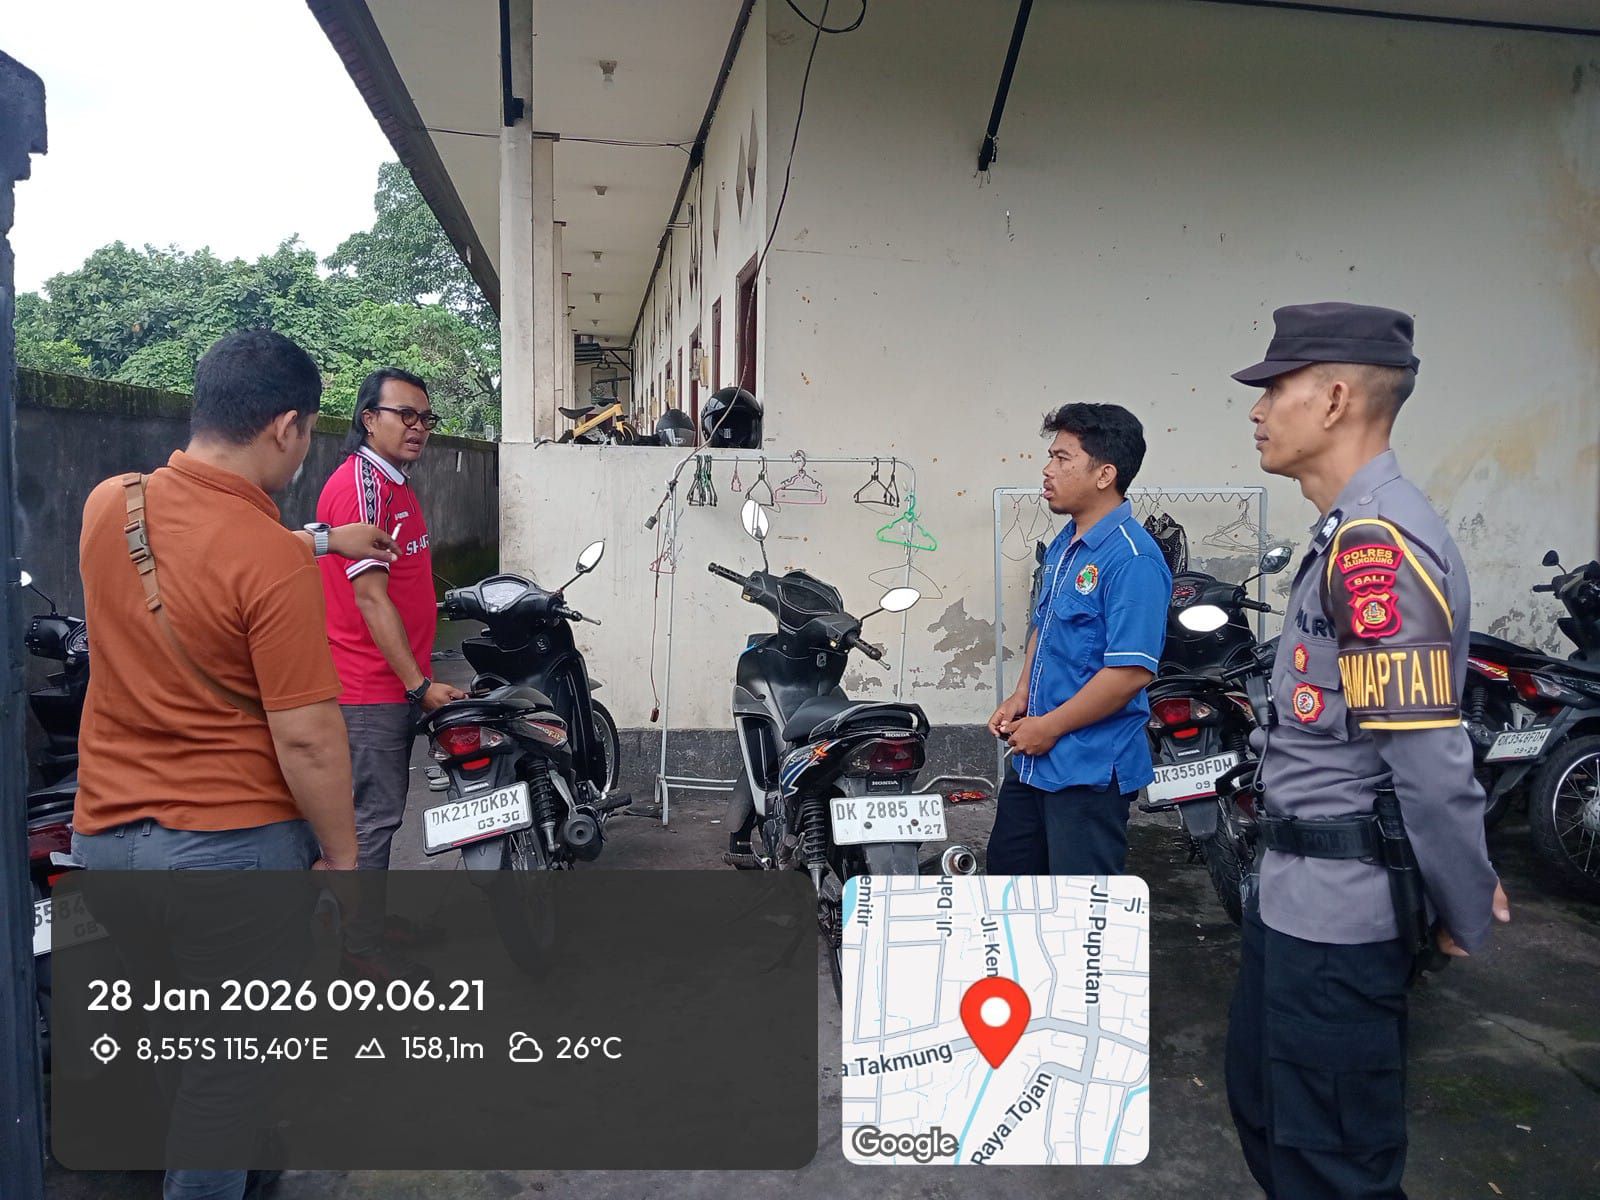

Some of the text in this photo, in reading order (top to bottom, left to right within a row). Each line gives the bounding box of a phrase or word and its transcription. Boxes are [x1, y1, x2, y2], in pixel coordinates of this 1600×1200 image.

[1343, 548, 1393, 563] POLRES
[1354, 575, 1385, 586] BALI
[1430, 650, 1452, 706] III
[835, 799, 941, 821] DK 2885 KC
